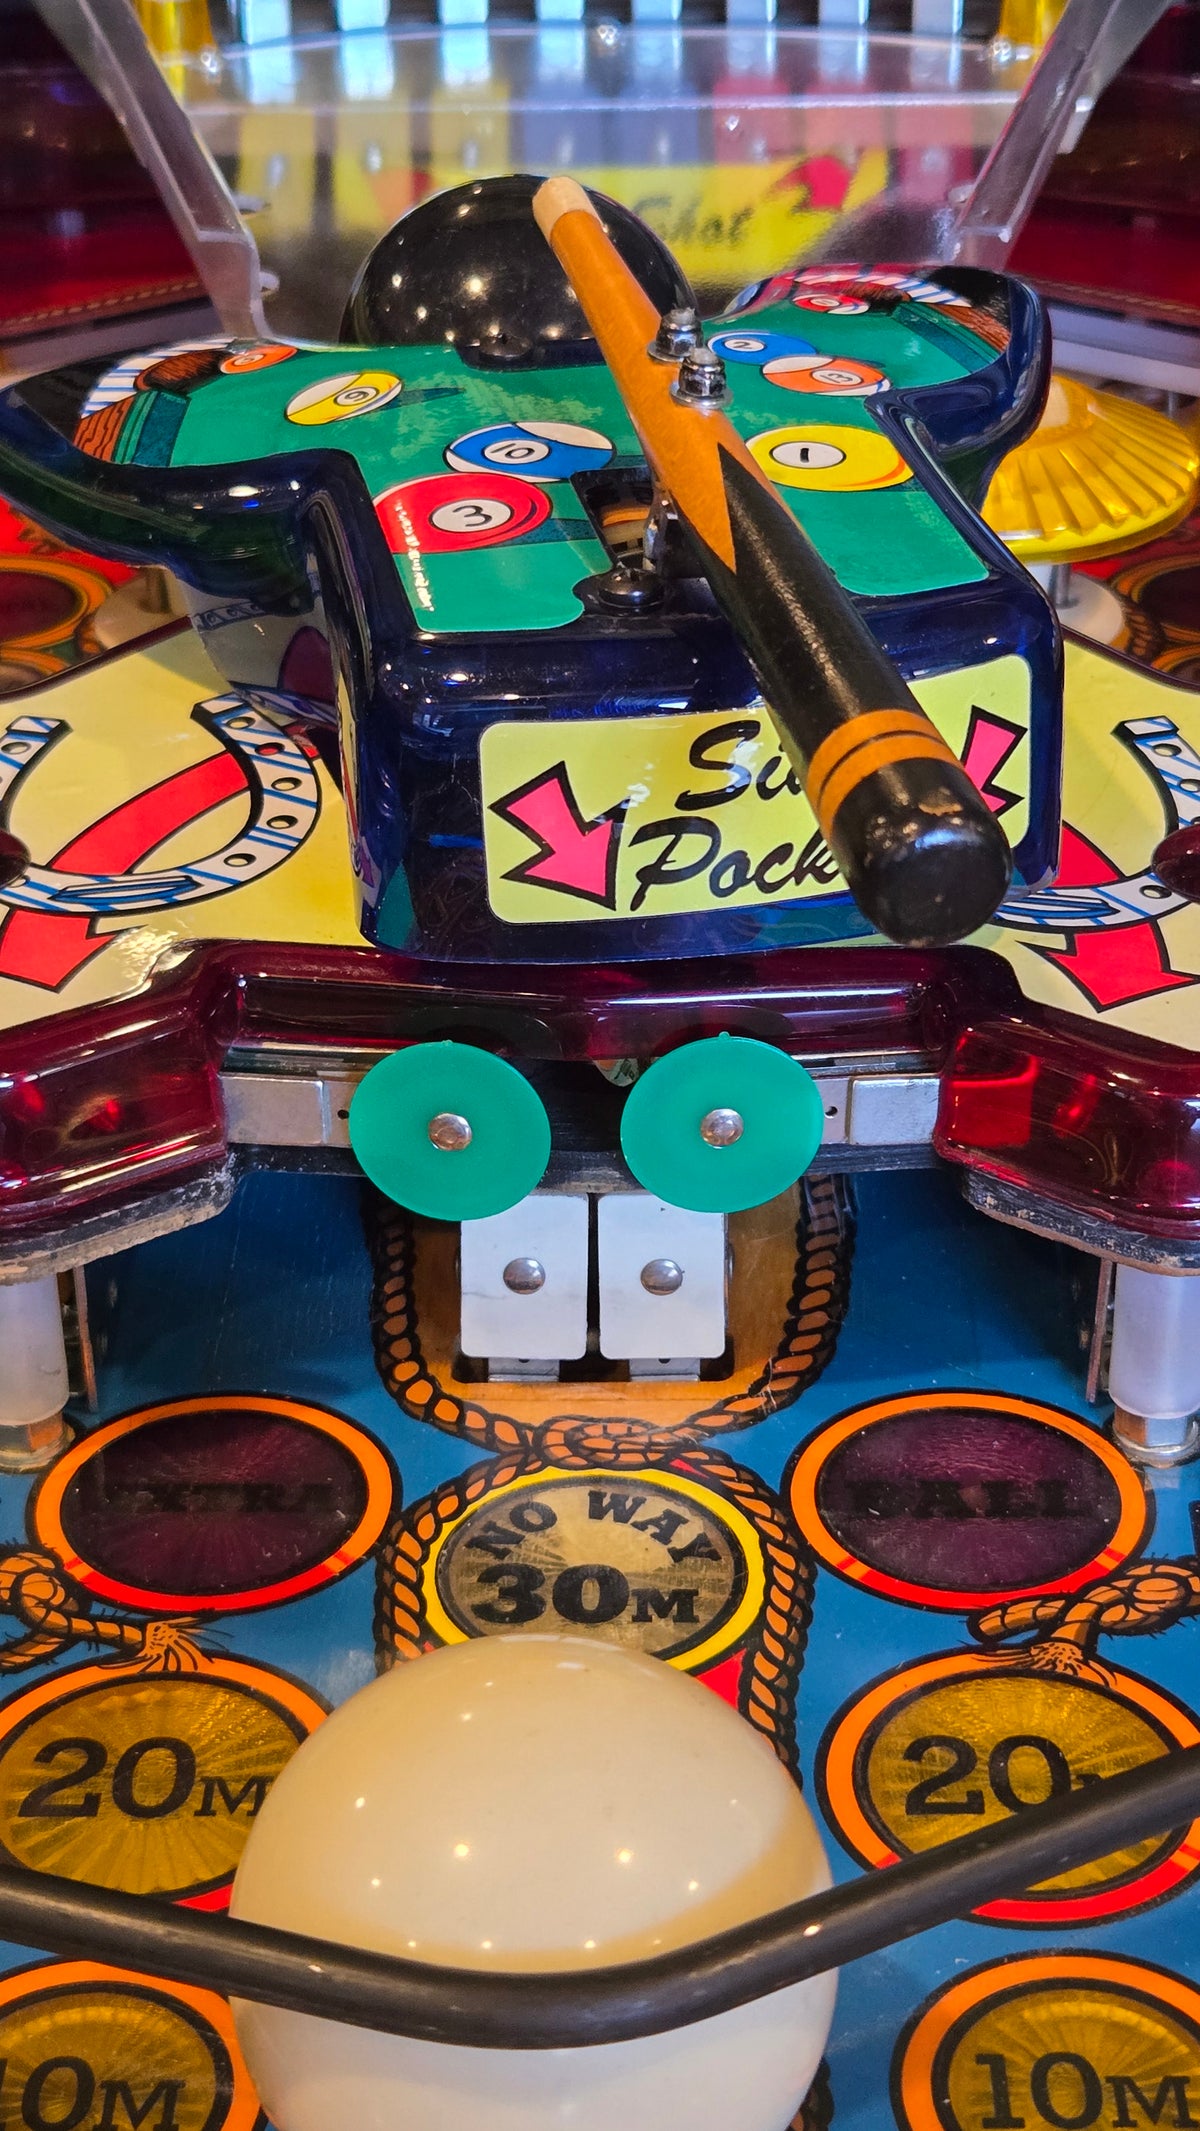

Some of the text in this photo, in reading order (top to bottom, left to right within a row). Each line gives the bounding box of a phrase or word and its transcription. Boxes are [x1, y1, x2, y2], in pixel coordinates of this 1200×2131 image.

[733, 341, 753, 350] 2
[344, 390, 370, 402] 9
[819, 372, 854, 384] 13
[488, 442, 535, 459] 10
[799, 447, 810, 463] 1
[452, 504, 493, 528] 3
[674, 719, 802, 811] Si
[628, 815, 843, 912] Pock
[464, 1489, 722, 1564] NO WAY
[470, 1562, 700, 1624] 30M
[18, 1735, 275, 1819] 20M
[903, 1734, 1104, 1817] 20
[975, 2051, 1200, 2130] 10M
